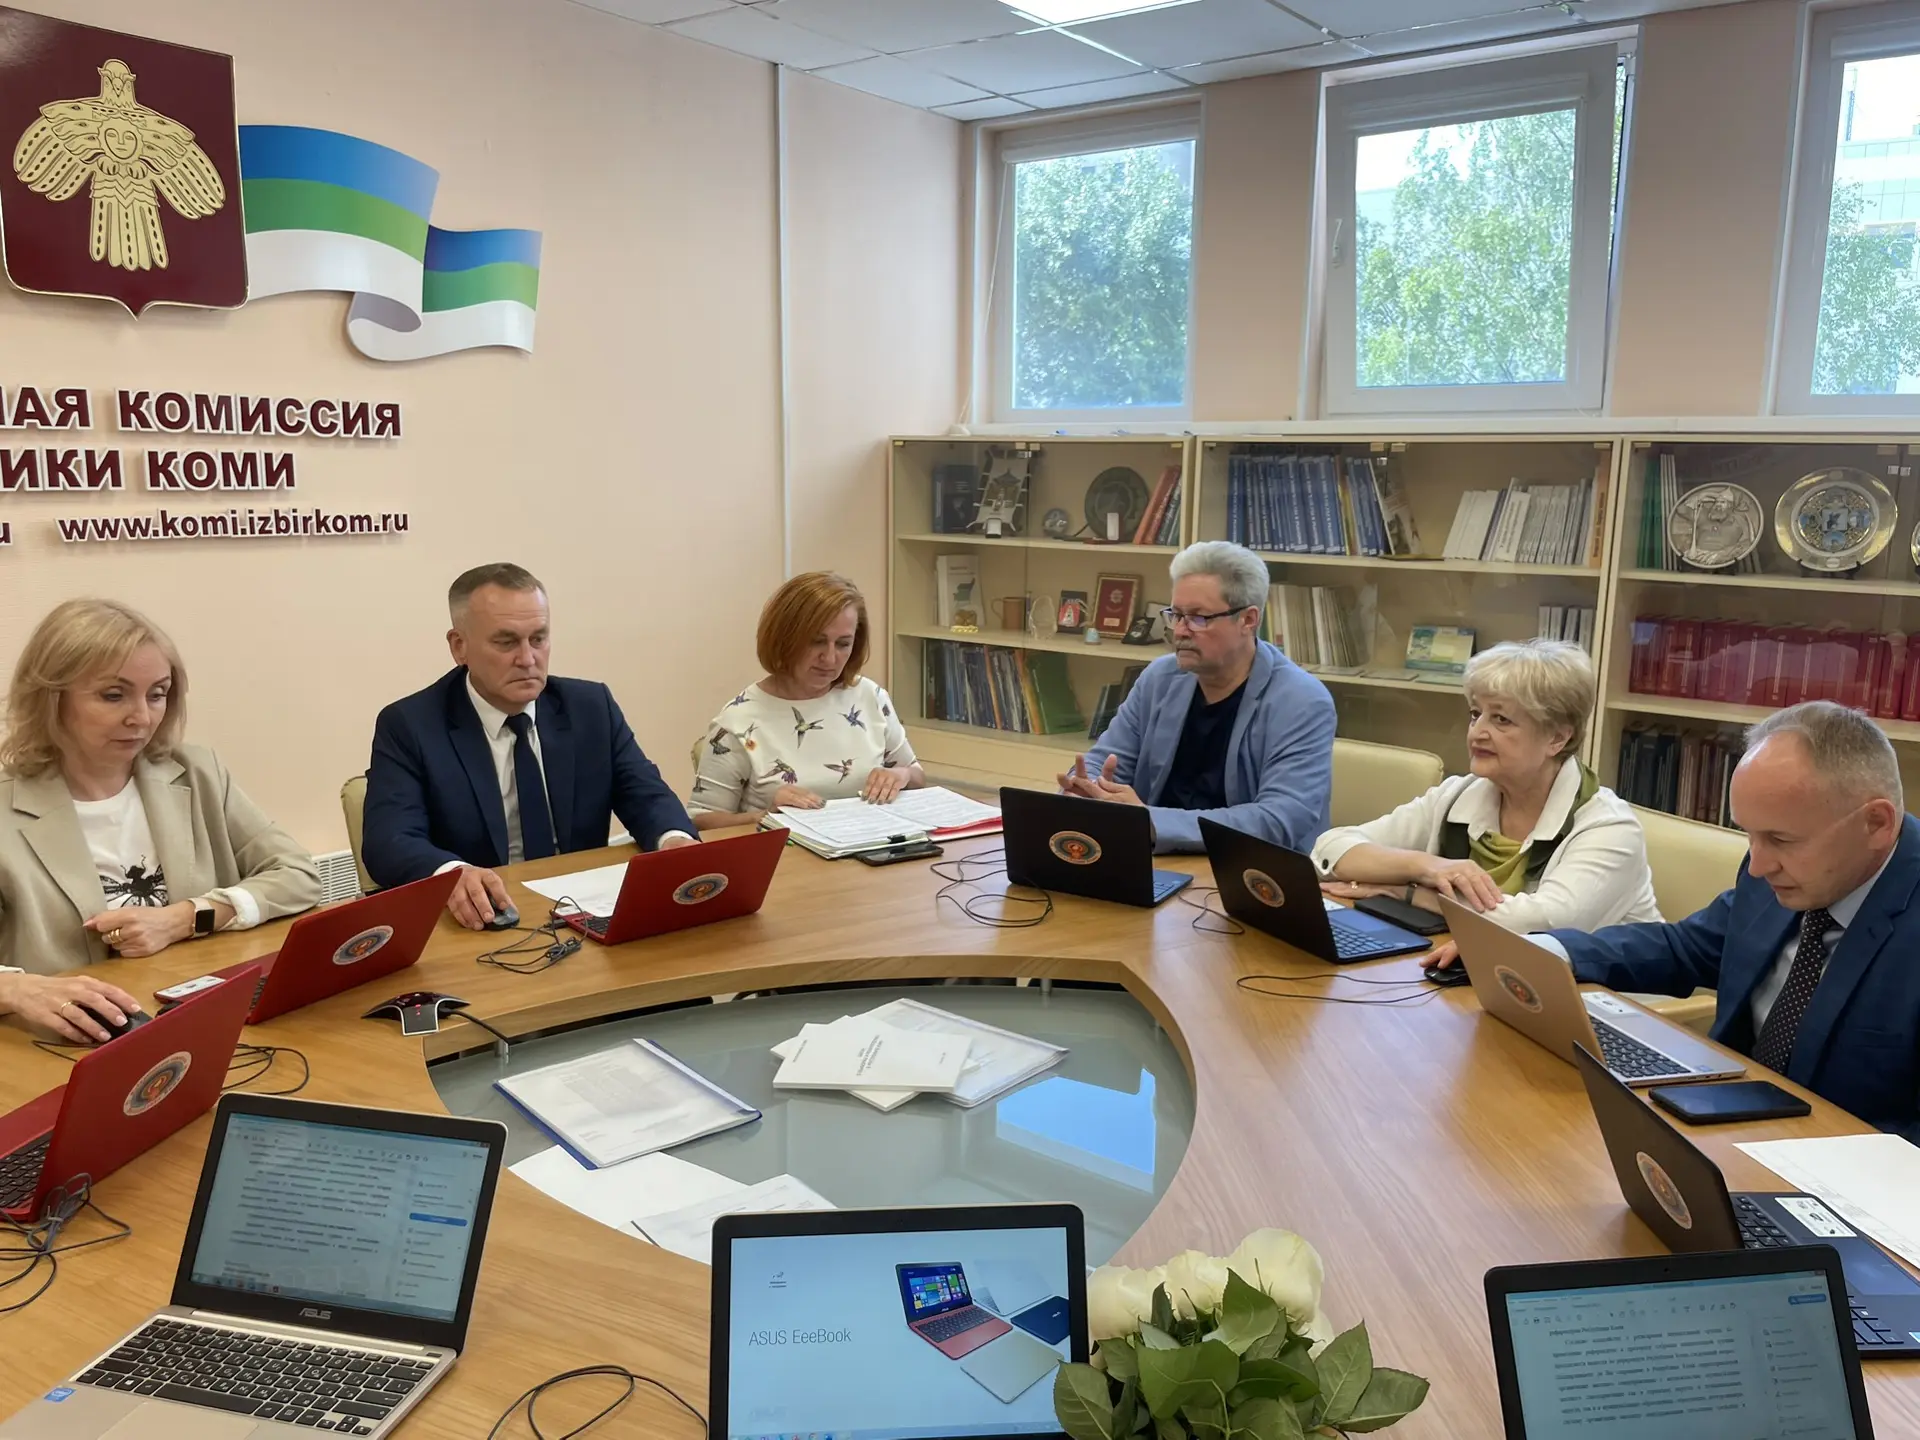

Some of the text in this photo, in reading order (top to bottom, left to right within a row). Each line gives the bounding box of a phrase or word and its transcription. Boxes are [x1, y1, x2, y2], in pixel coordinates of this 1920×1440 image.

[0, 385, 402, 437] АЯ КОМИССИЯ
[0, 448, 296, 489] ИКИ КОМИ
[57, 508, 409, 541] www.komi.izbirkom.ru
[299, 1307, 332, 1320] ASUS
[748, 1327, 852, 1346] ASUS EeeBook
